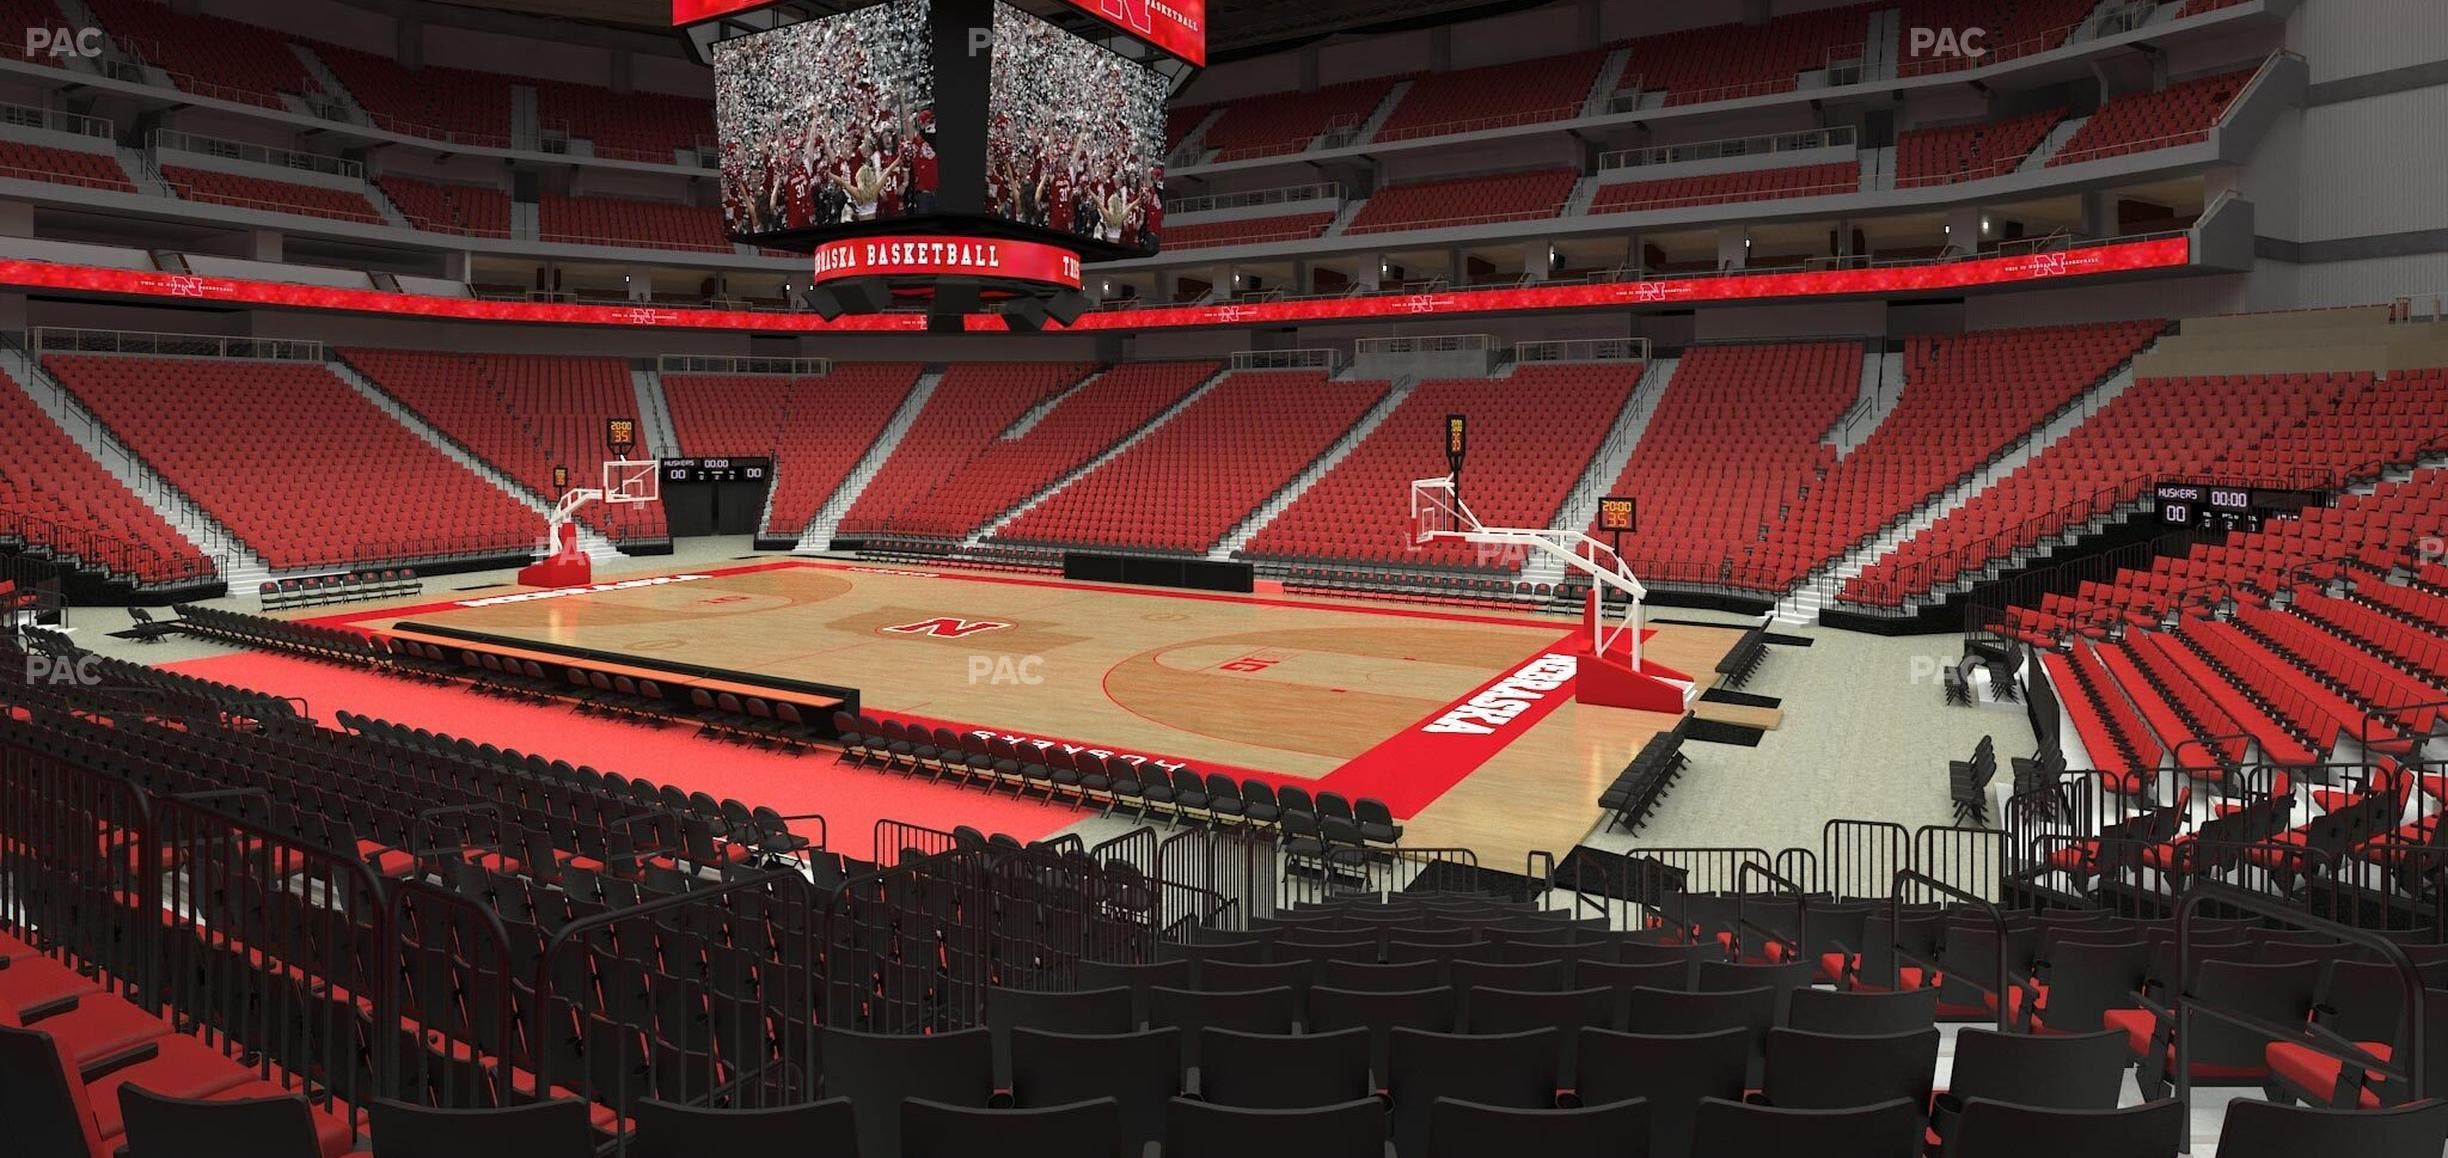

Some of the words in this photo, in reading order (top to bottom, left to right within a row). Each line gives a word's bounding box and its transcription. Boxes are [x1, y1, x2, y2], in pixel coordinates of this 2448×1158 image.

[867, 242, 999, 267] BASKETBALL
[611, 421, 632, 431] 20:00
[615, 431, 629, 442] 35
[670, 469, 686, 480] 00
[746, 468, 762, 478] 00
[2158, 487, 2198, 500] HUSKERS
[2212, 491, 2247, 508] 00:00
[1602, 501, 1632, 512] 20:00
[2166, 505, 2186, 522] 00
[1608, 513, 1627, 527] 35
[882, 617, 1011, 638] N
